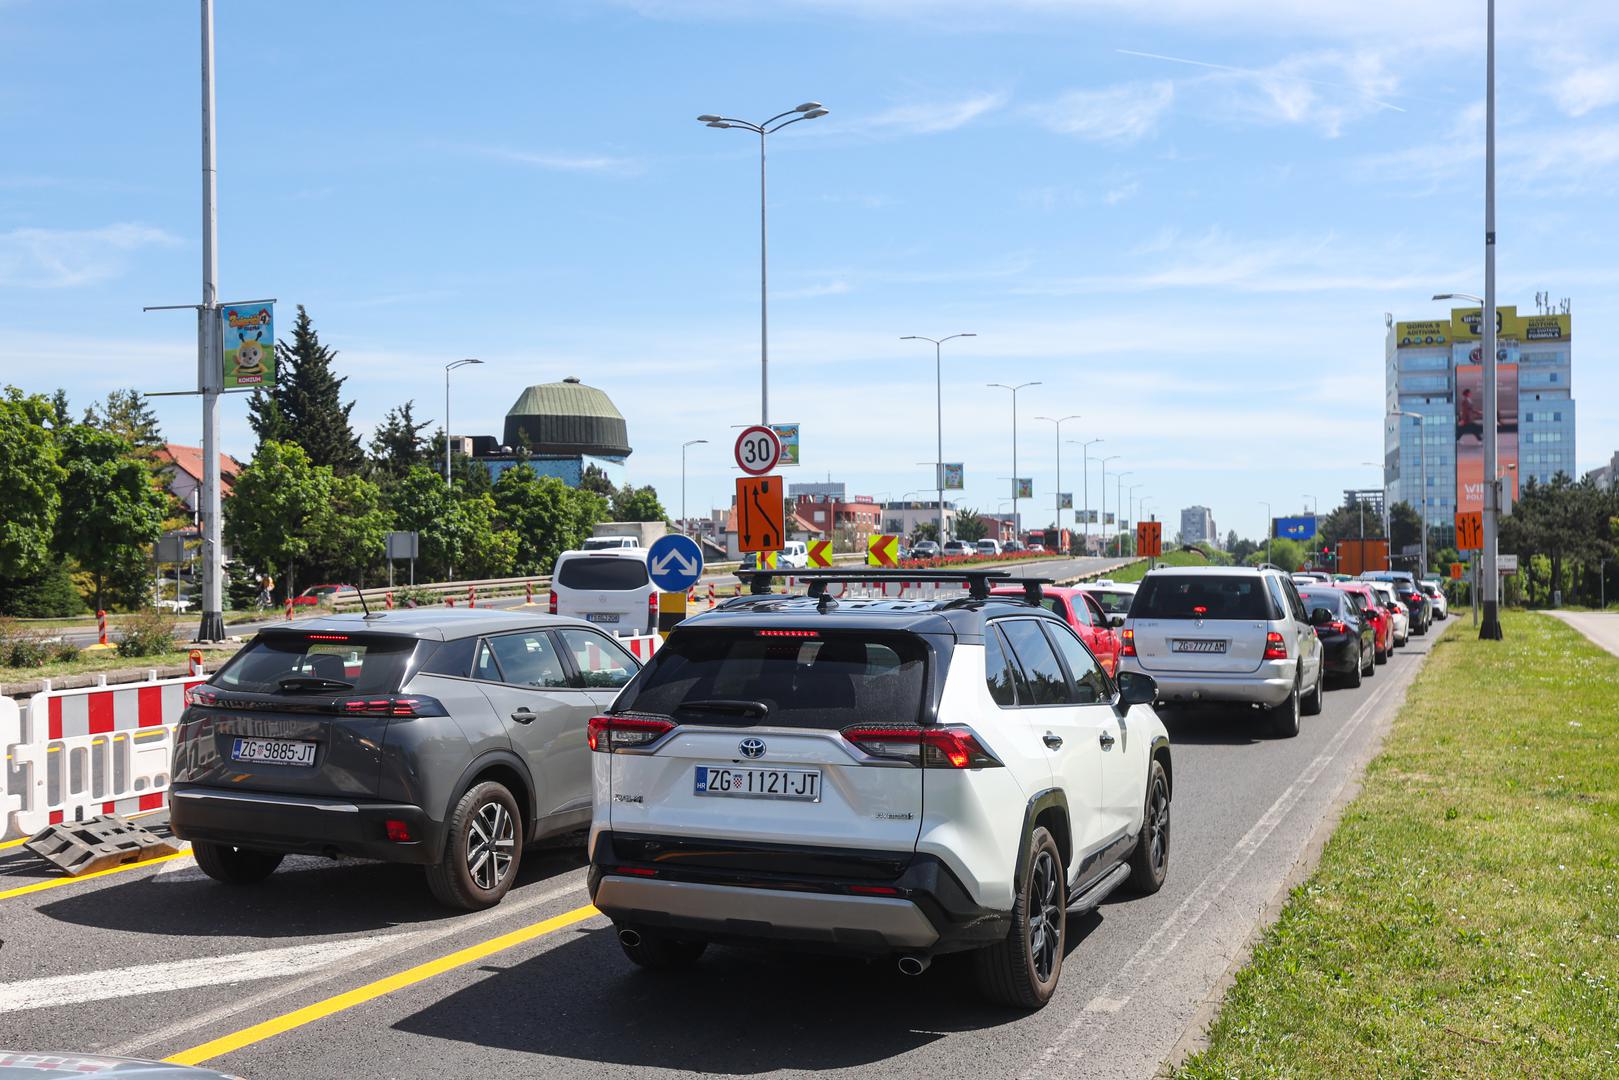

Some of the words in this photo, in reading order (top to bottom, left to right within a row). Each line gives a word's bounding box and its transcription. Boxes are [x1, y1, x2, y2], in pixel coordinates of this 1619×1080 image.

[744, 437, 770, 464] 30
[241, 741, 257, 757] ZG
[696, 782, 706, 790] HR
[708, 770, 731, 791] ZG
